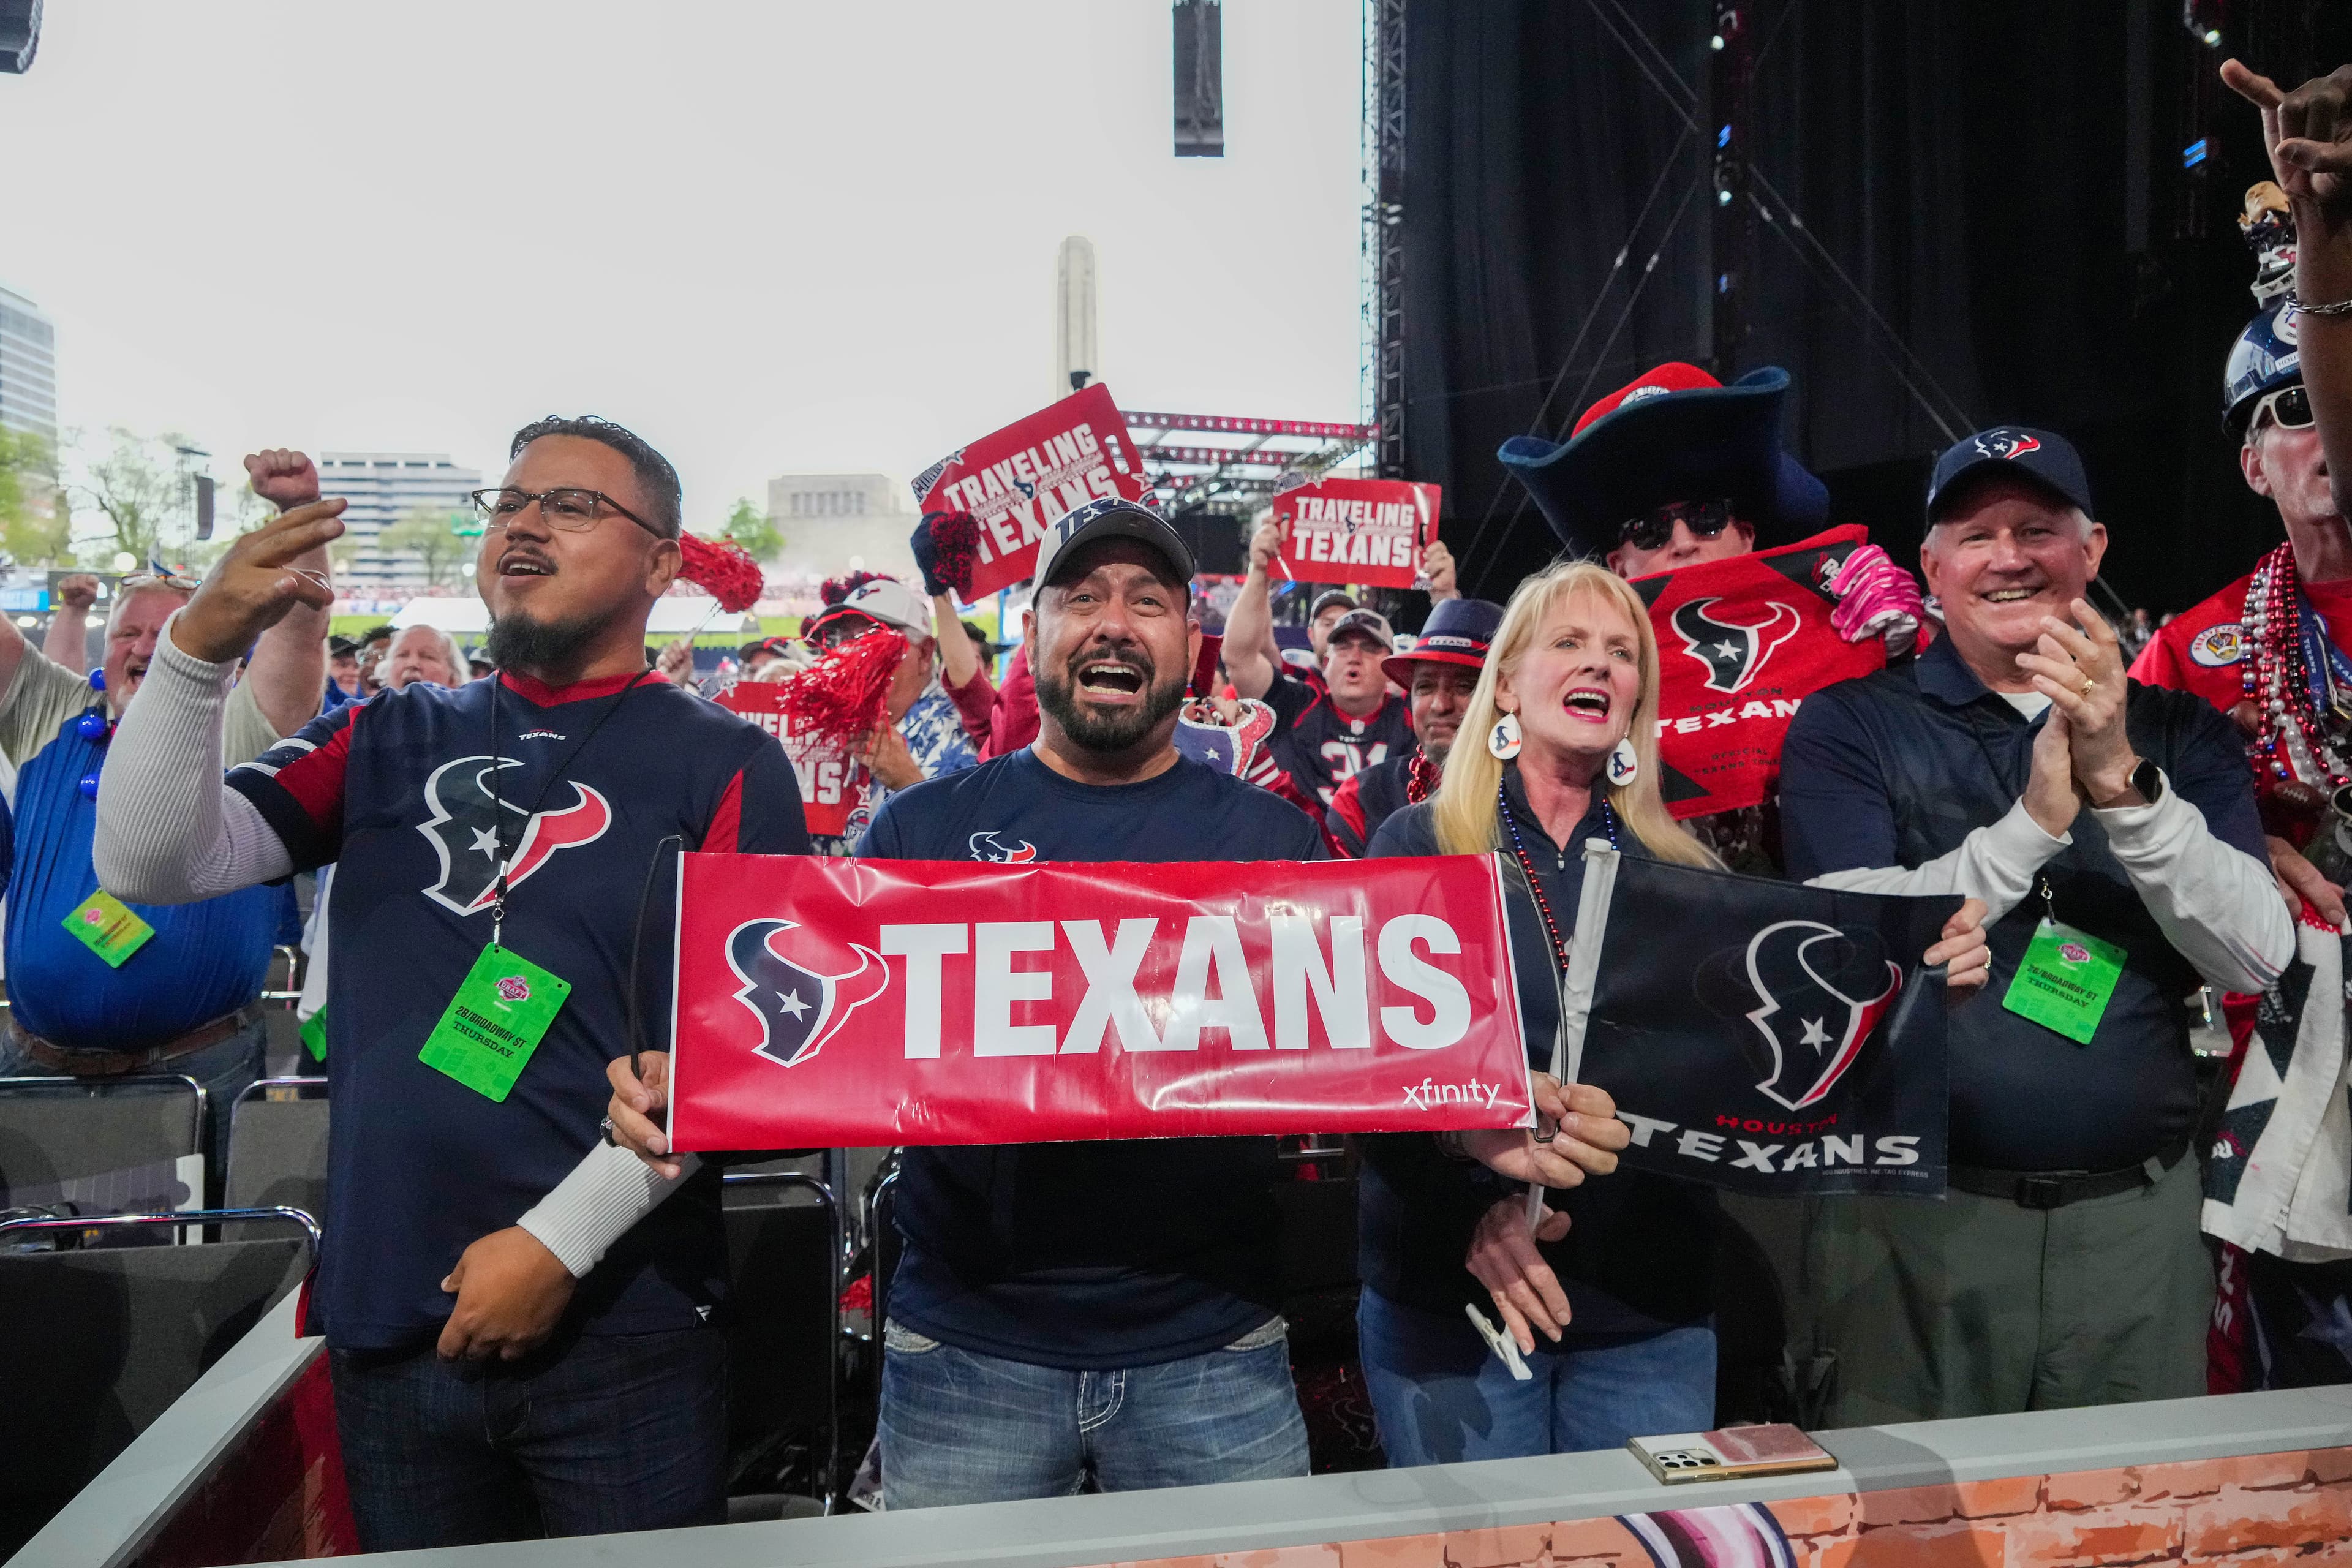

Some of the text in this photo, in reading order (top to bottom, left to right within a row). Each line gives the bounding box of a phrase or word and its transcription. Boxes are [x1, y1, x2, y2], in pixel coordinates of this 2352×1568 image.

[943, 423, 1099, 513] TRAVELING
[971, 464, 1121, 564] TEXANS
[1295, 496, 1415, 527] TRAVELING
[1292, 528, 1412, 567] TEXANS
[1653, 699, 1802, 738] TEXAN
[1689, 687, 1783, 712] HOUSTON
[519, 731, 567, 741] TEXANS
[500, 982, 525, 998] DRAFT
[880, 914, 1471, 1059] TEXANS
[2028, 978, 2089, 1008] THURSDAY
[453, 1020, 515, 1059] THURSDAY
[454, 1005, 527, 1049] 2B/BROADWAY ST
[1403, 1076, 1501, 1111] xfinity
[1615, 1110, 1920, 1174] TEXANS
[1715, 1113, 1838, 1135] HOUSTON
